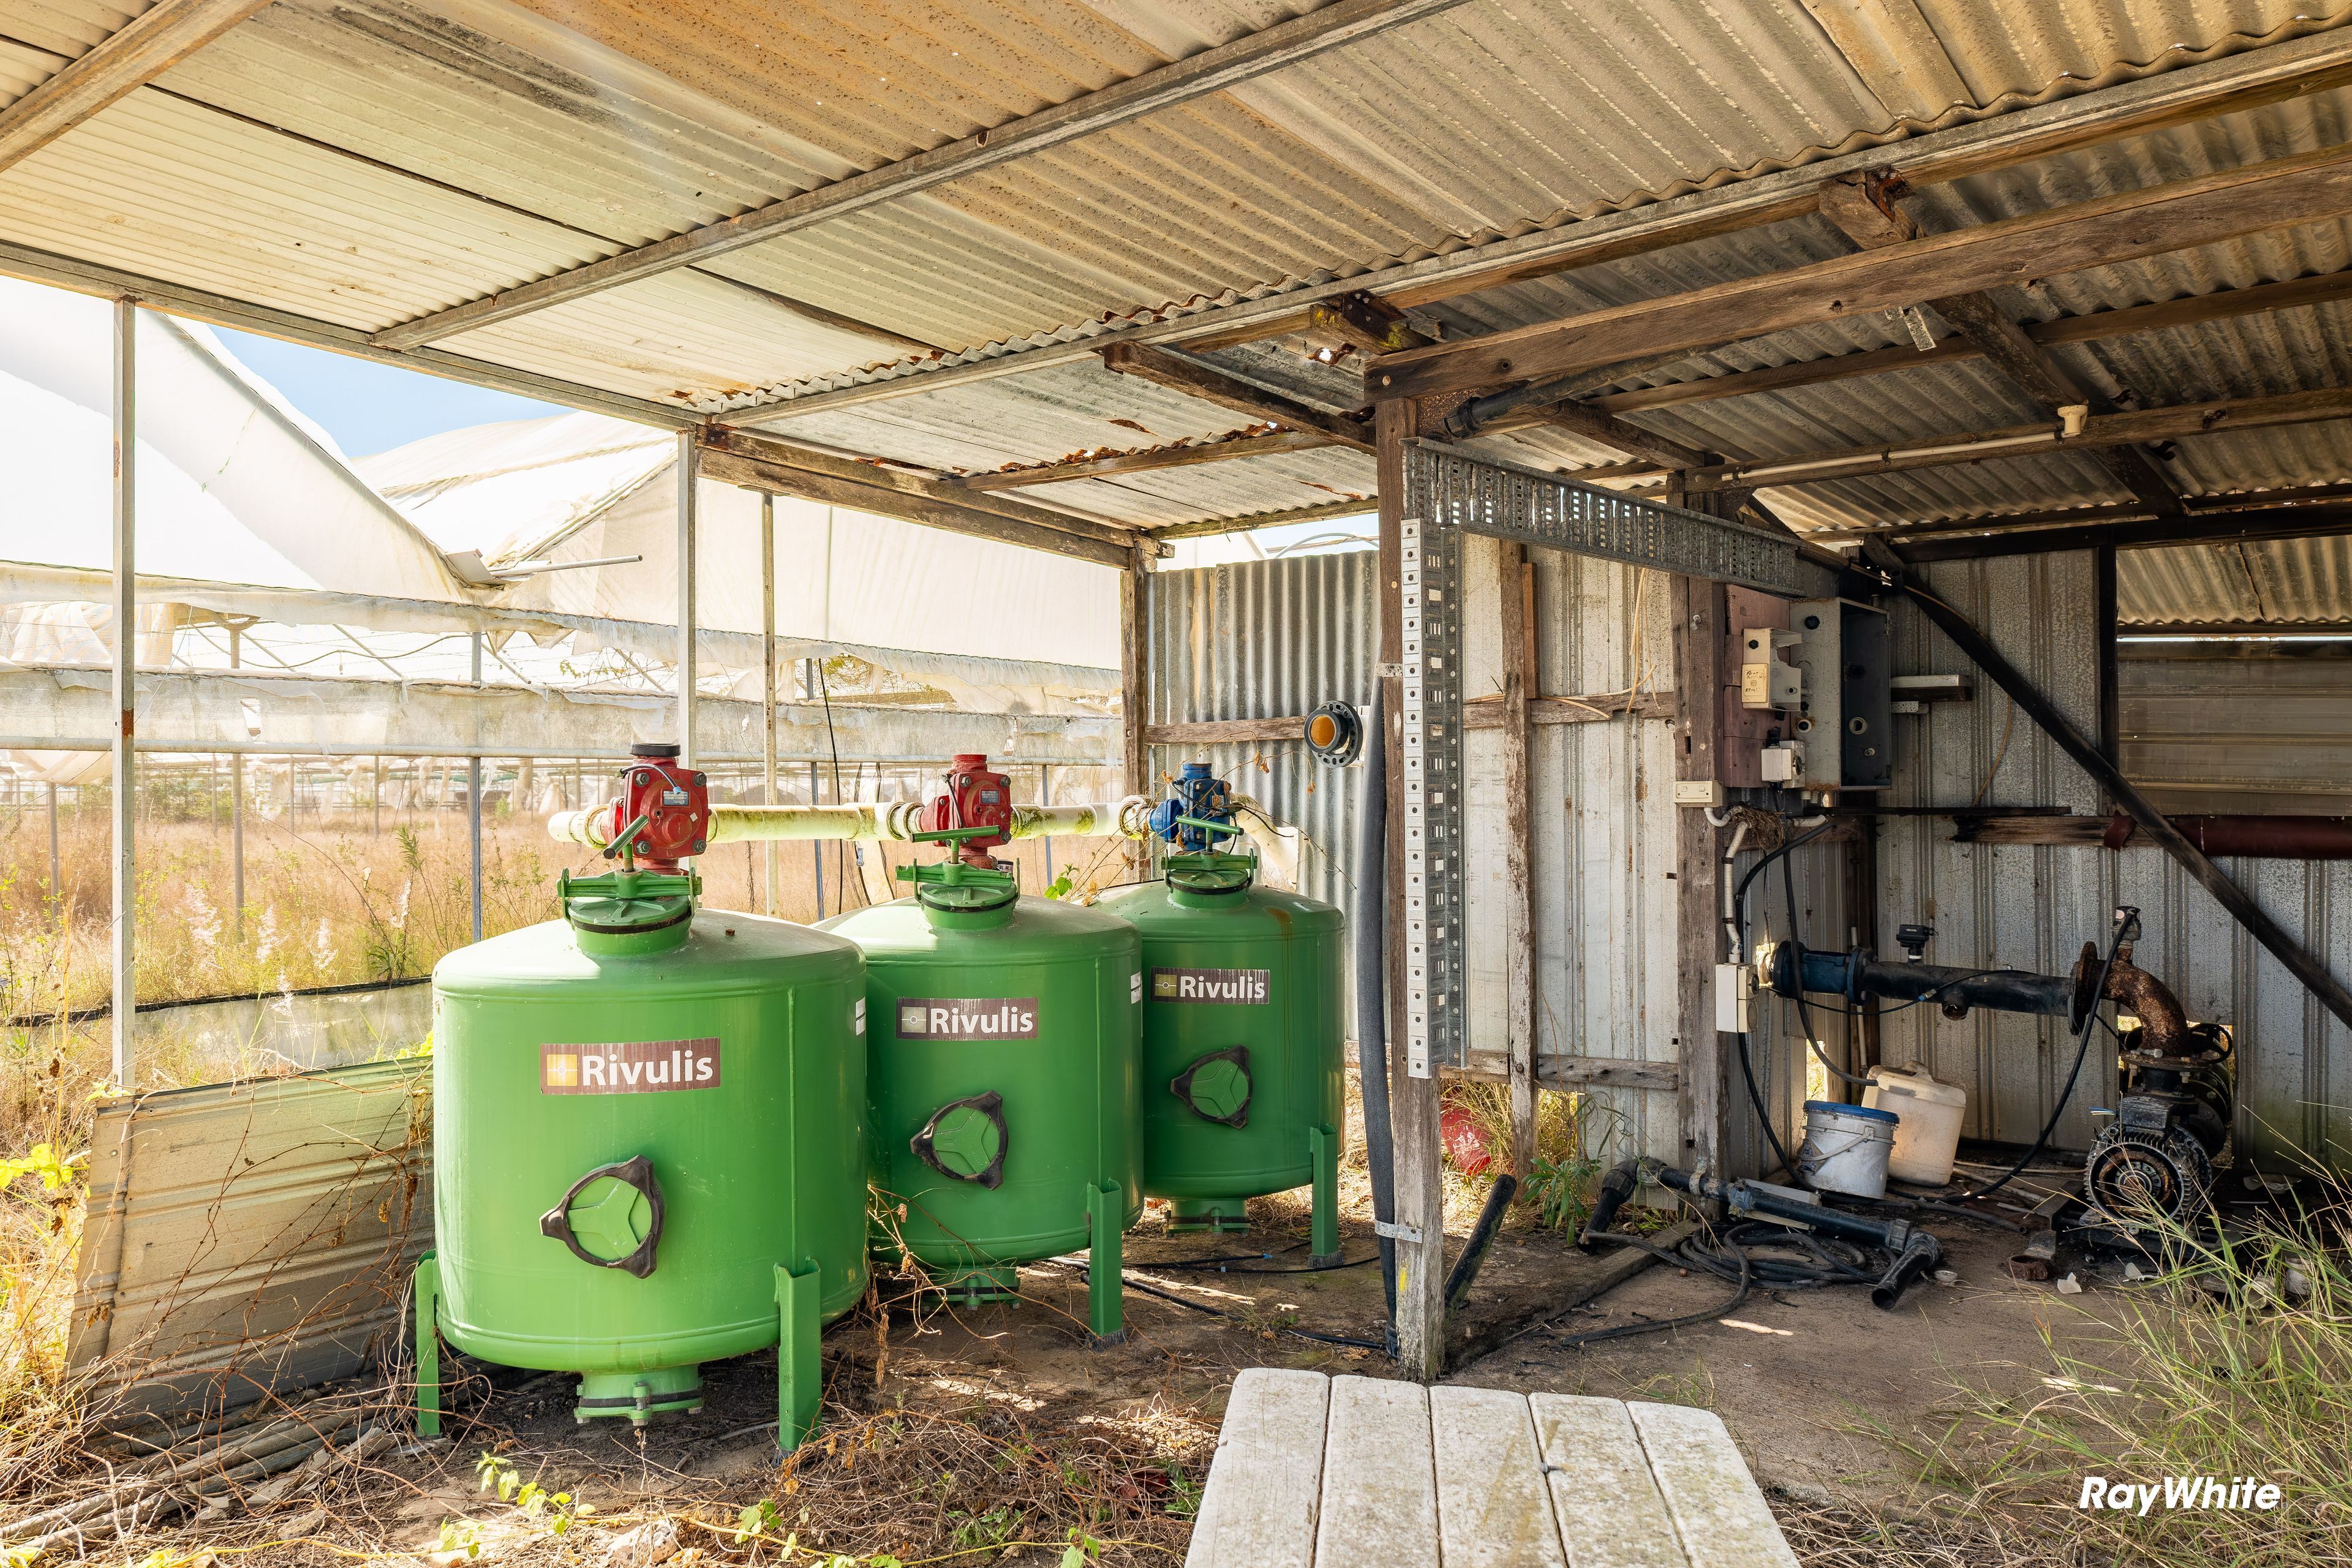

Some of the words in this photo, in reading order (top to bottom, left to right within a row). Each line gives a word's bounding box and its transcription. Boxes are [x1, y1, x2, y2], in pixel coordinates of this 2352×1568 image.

[1180, 976, 1265, 999] Rivulis
[930, 1006, 1034, 1034] Rivulis
[582, 1049, 714, 1087] Rivulis
